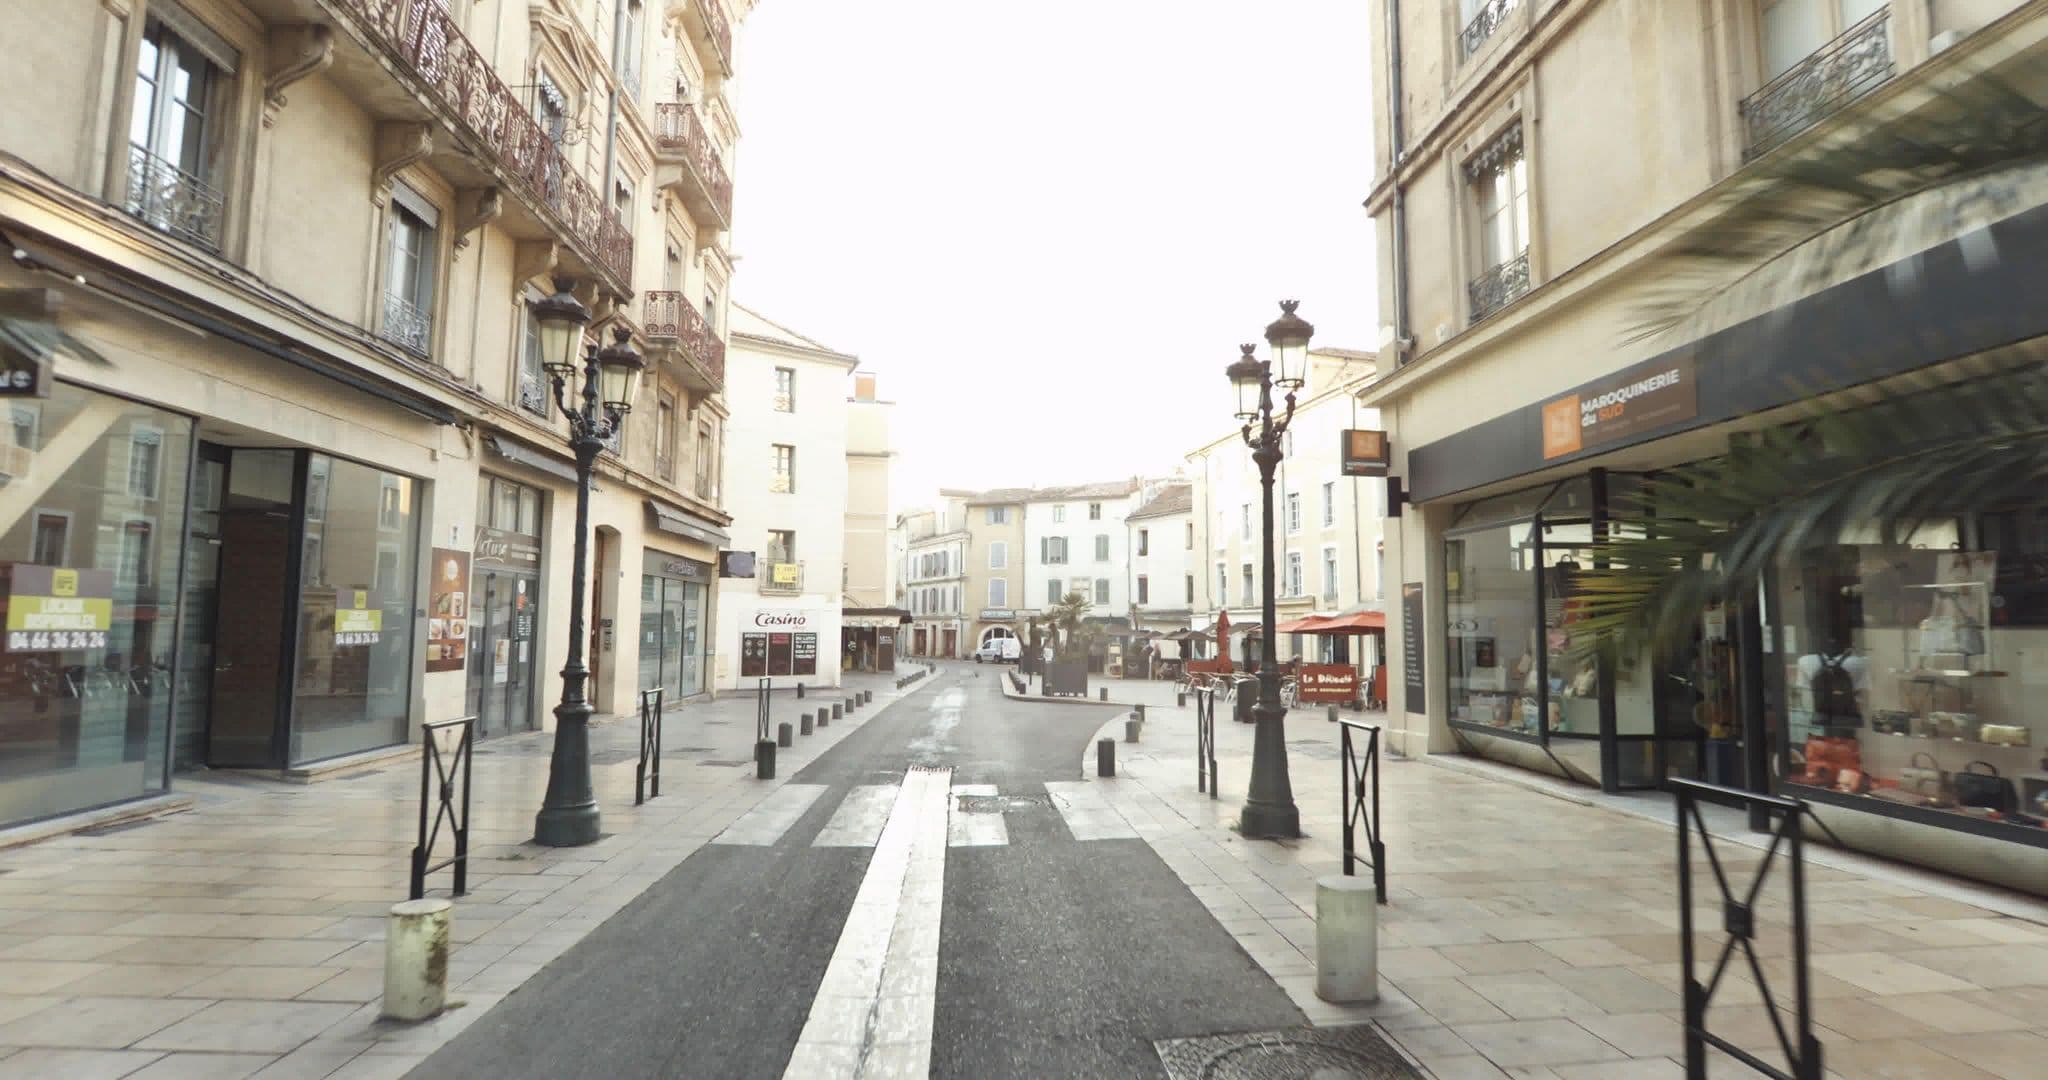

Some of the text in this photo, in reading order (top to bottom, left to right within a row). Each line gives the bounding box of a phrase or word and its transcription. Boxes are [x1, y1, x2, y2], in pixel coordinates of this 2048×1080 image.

[1581, 368, 1680, 414] MAROQUINERIE
[1581, 410, 1597, 427] du
[1599, 404, 1625, 421] SUD
[755, 612, 806, 627] Casino
[9, 631, 29, 649] 04
[31, 631, 49, 648] 66
[1302, 674, 1313, 683] Le
